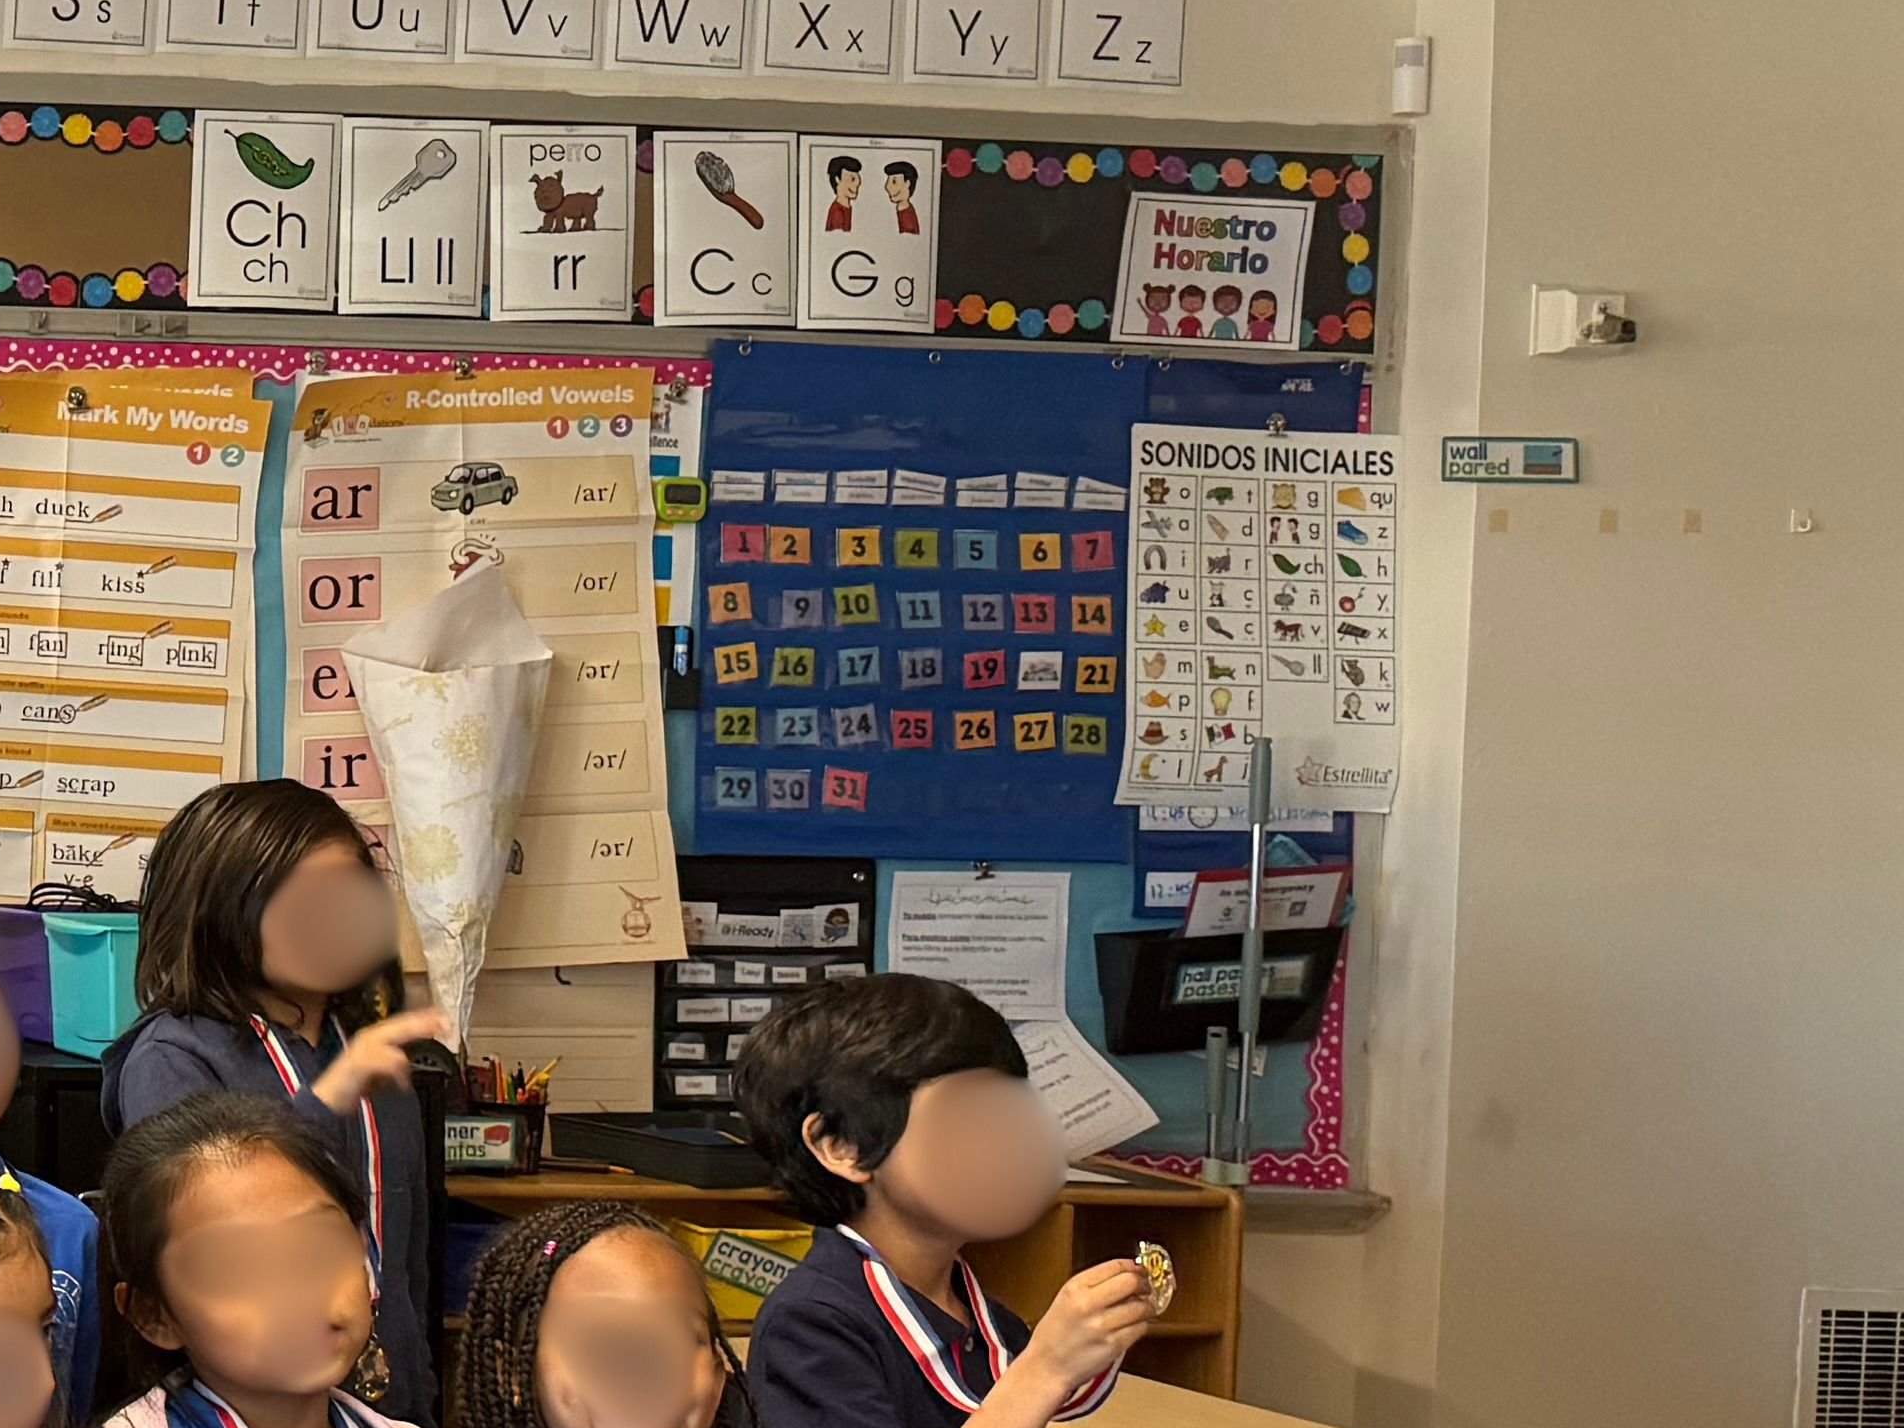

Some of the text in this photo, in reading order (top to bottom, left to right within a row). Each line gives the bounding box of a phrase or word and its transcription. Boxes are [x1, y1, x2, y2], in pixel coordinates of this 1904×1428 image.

[530, 144, 601, 166] perro
[227, 198, 306, 252] Ch
[1154, 208, 1275, 241] Nuestro
[243, 252, 288, 284] ch
[554, 254, 583, 290] rr
[1153, 241, 1269, 276] Horario
[406, 385, 634, 410] R-Controlled Vowels
[127, 406, 163, 431] My
[169, 409, 249, 434] Words
[1141, 441, 1393, 476] SONIDOS INICIALES
[1450, 443, 1487, 461] wall
[1450, 458, 1509, 476] pared
[35, 499, 90, 519] duck
[311, 482, 617, 520] ar /ar/
[102, 575, 145, 594] kiss
[308, 571, 617, 610] or /or/
[723, 652, 1108, 685] 15 16 17 18 19 21
[320, 747, 367, 789] ir
[1324, 765, 1388, 784] Estrellita
[57, 775, 115, 796] scrap
[1183, 982, 1239, 998] pases
[718, 1242, 789, 1279] crayon
